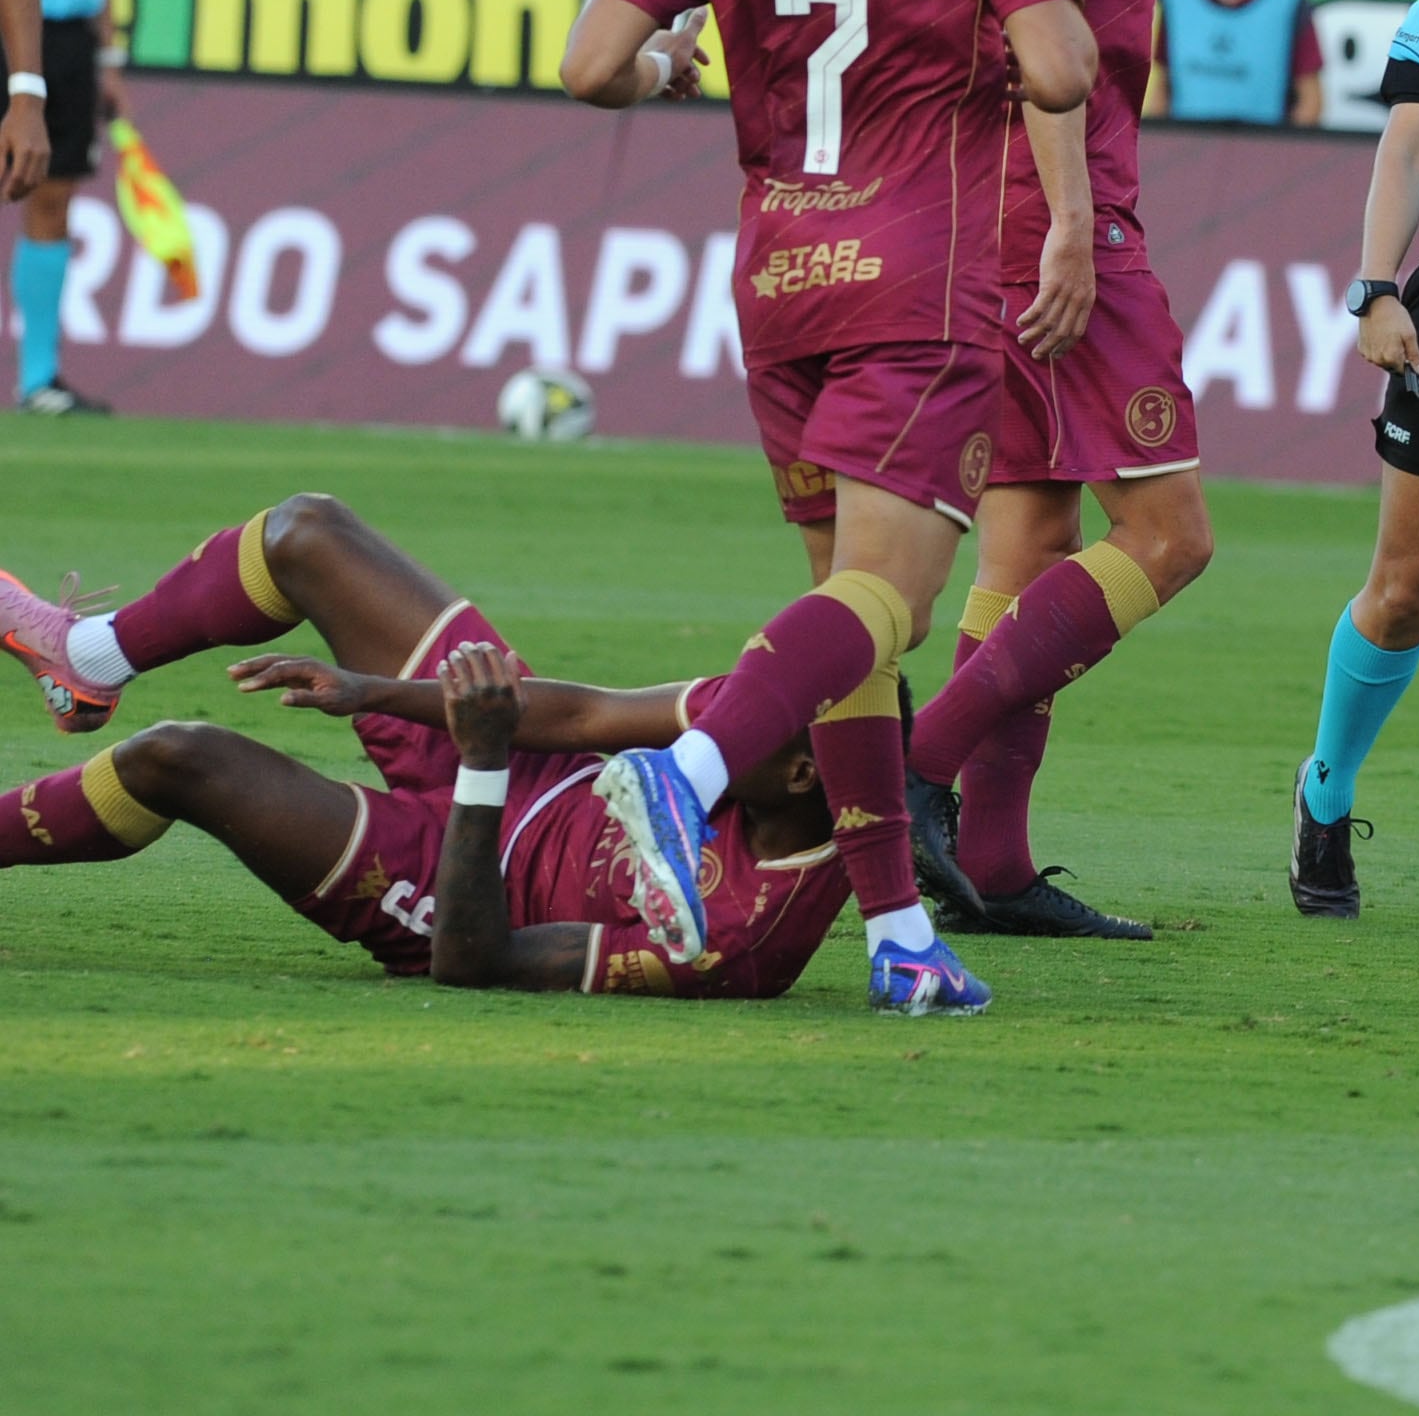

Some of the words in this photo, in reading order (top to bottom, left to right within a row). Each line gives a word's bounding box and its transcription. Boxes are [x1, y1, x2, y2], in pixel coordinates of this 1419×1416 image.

[761, 177, 883, 216] Tropical
[768, 239, 861, 274] STAR
[781, 257, 883, 294] CARS
[0, 195, 343, 359] RDO
[1183, 258, 1386, 414] AY
